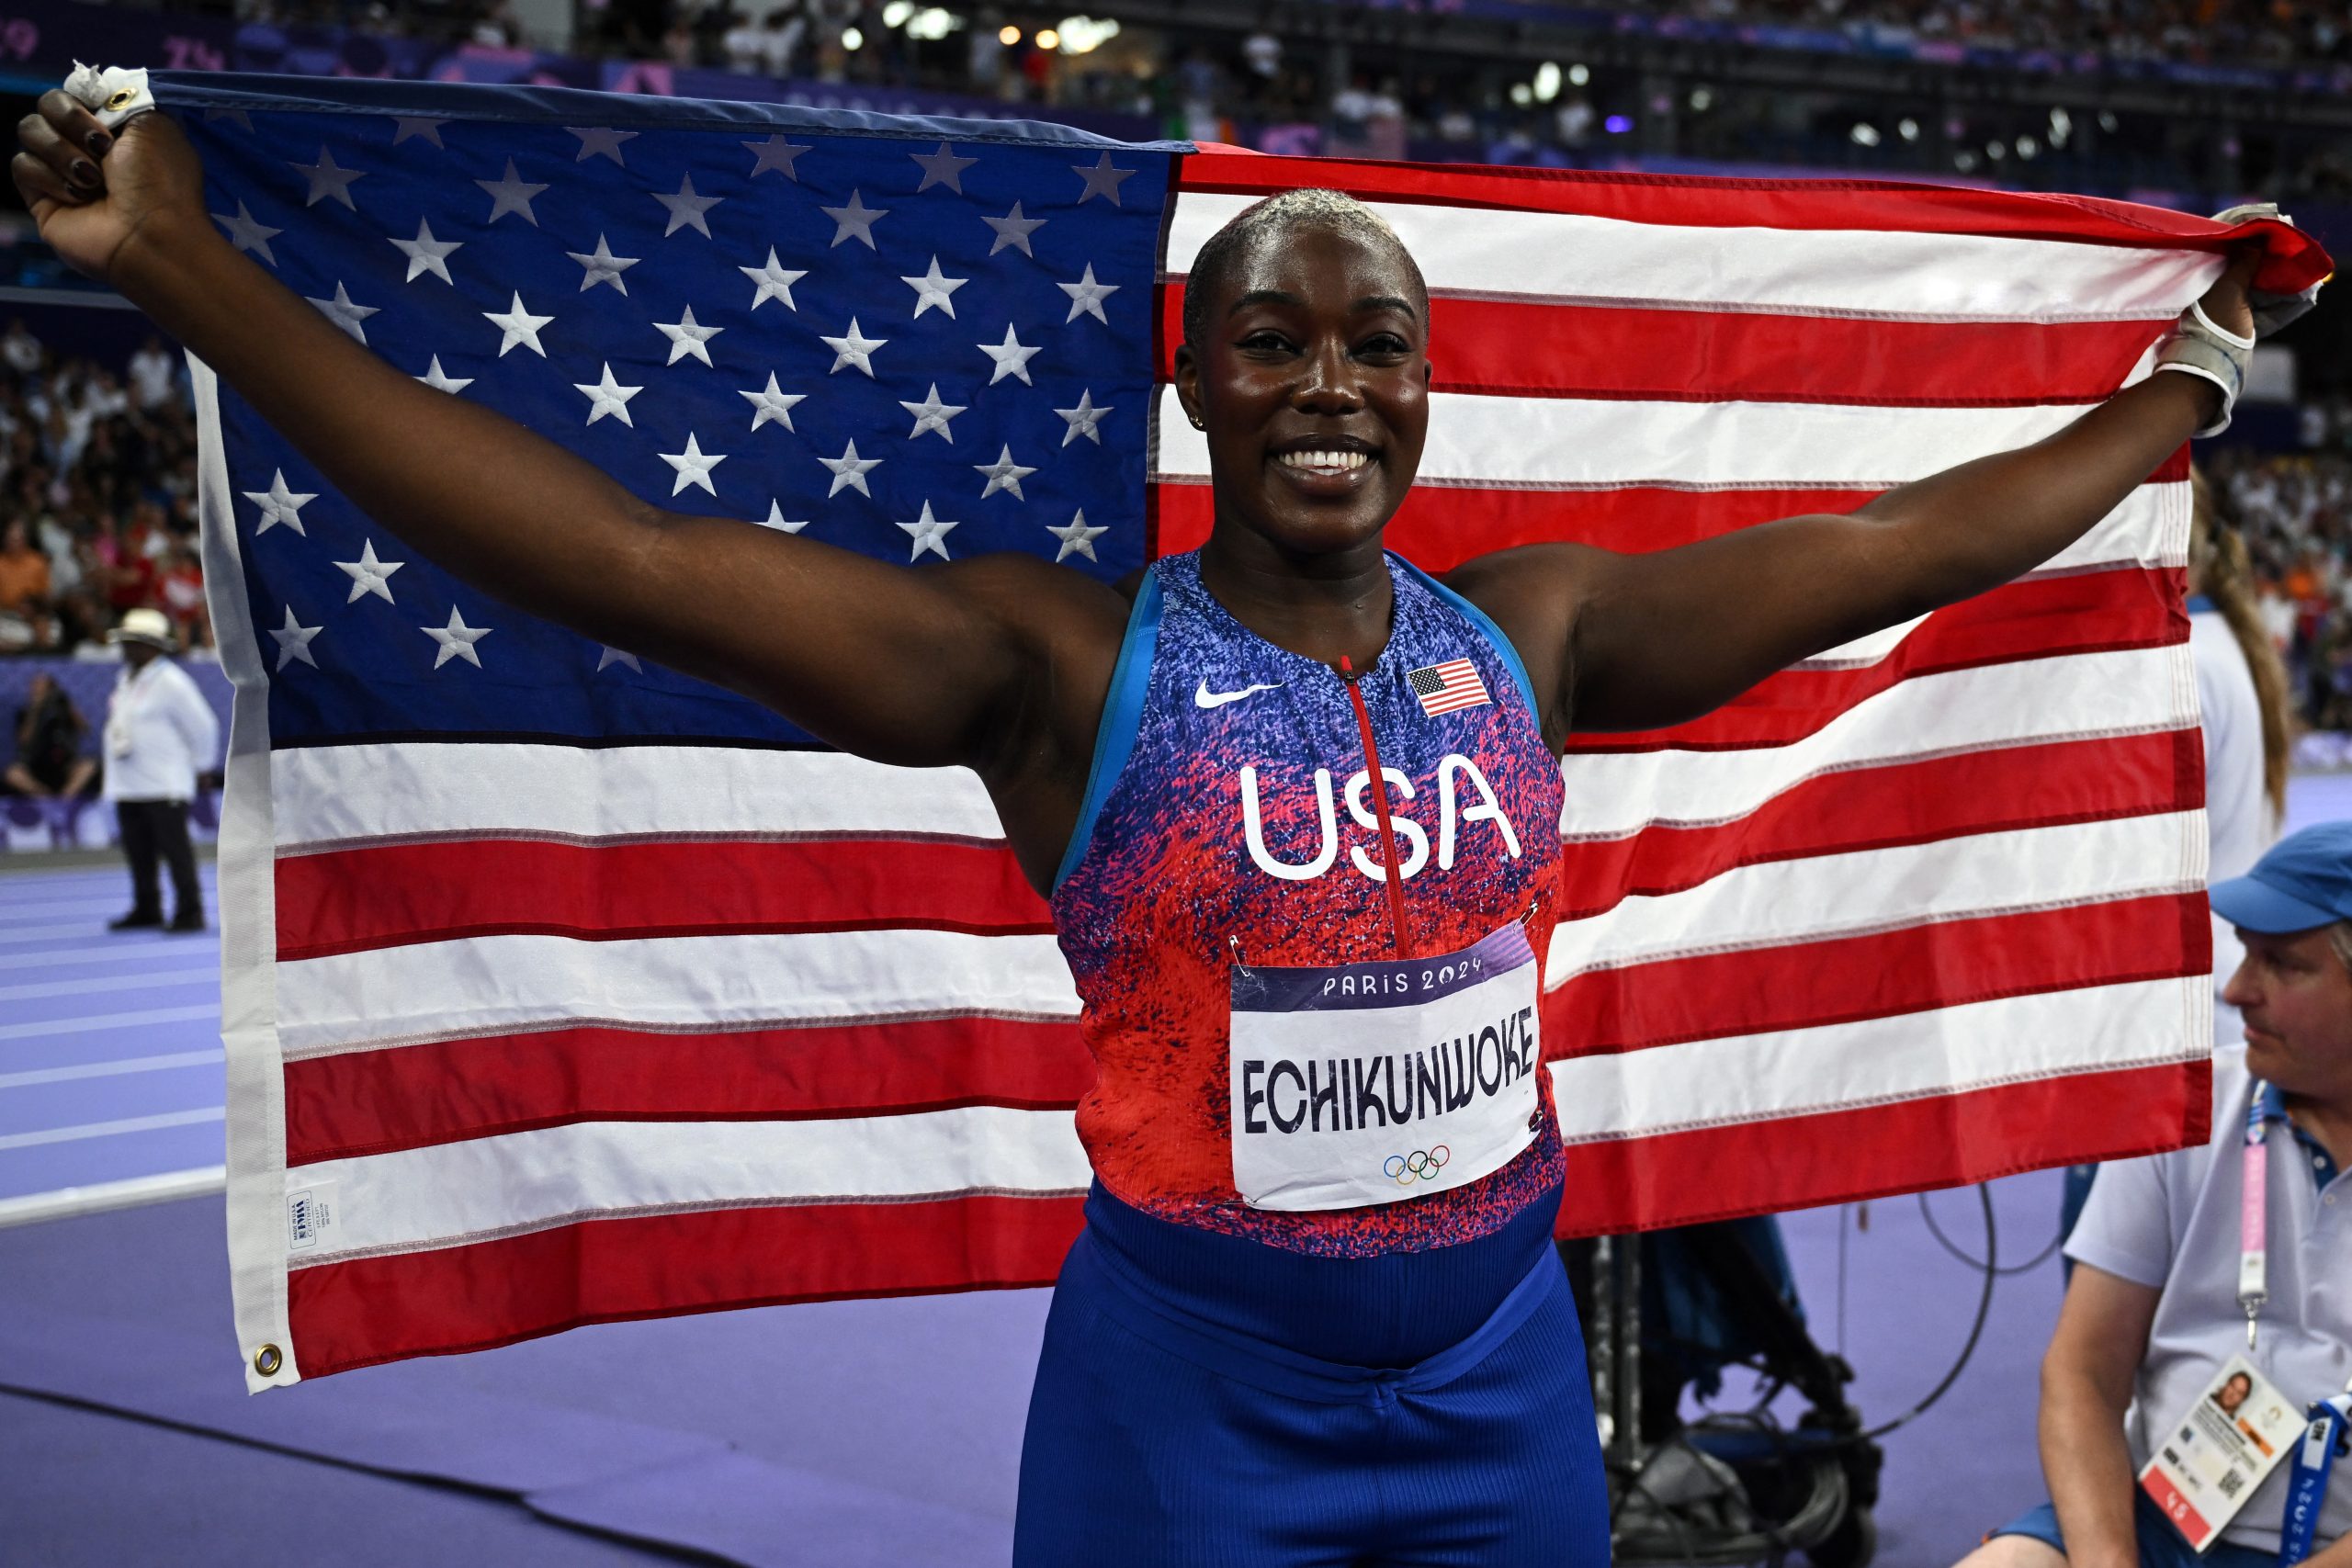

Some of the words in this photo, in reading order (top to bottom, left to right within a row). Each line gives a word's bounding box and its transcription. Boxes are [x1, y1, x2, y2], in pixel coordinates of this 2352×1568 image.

[1239, 753, 1521, 882] USA
[1420, 957, 1482, 990] 2024
[1242, 1007, 1532, 1134] ECHIKUNWOKE
